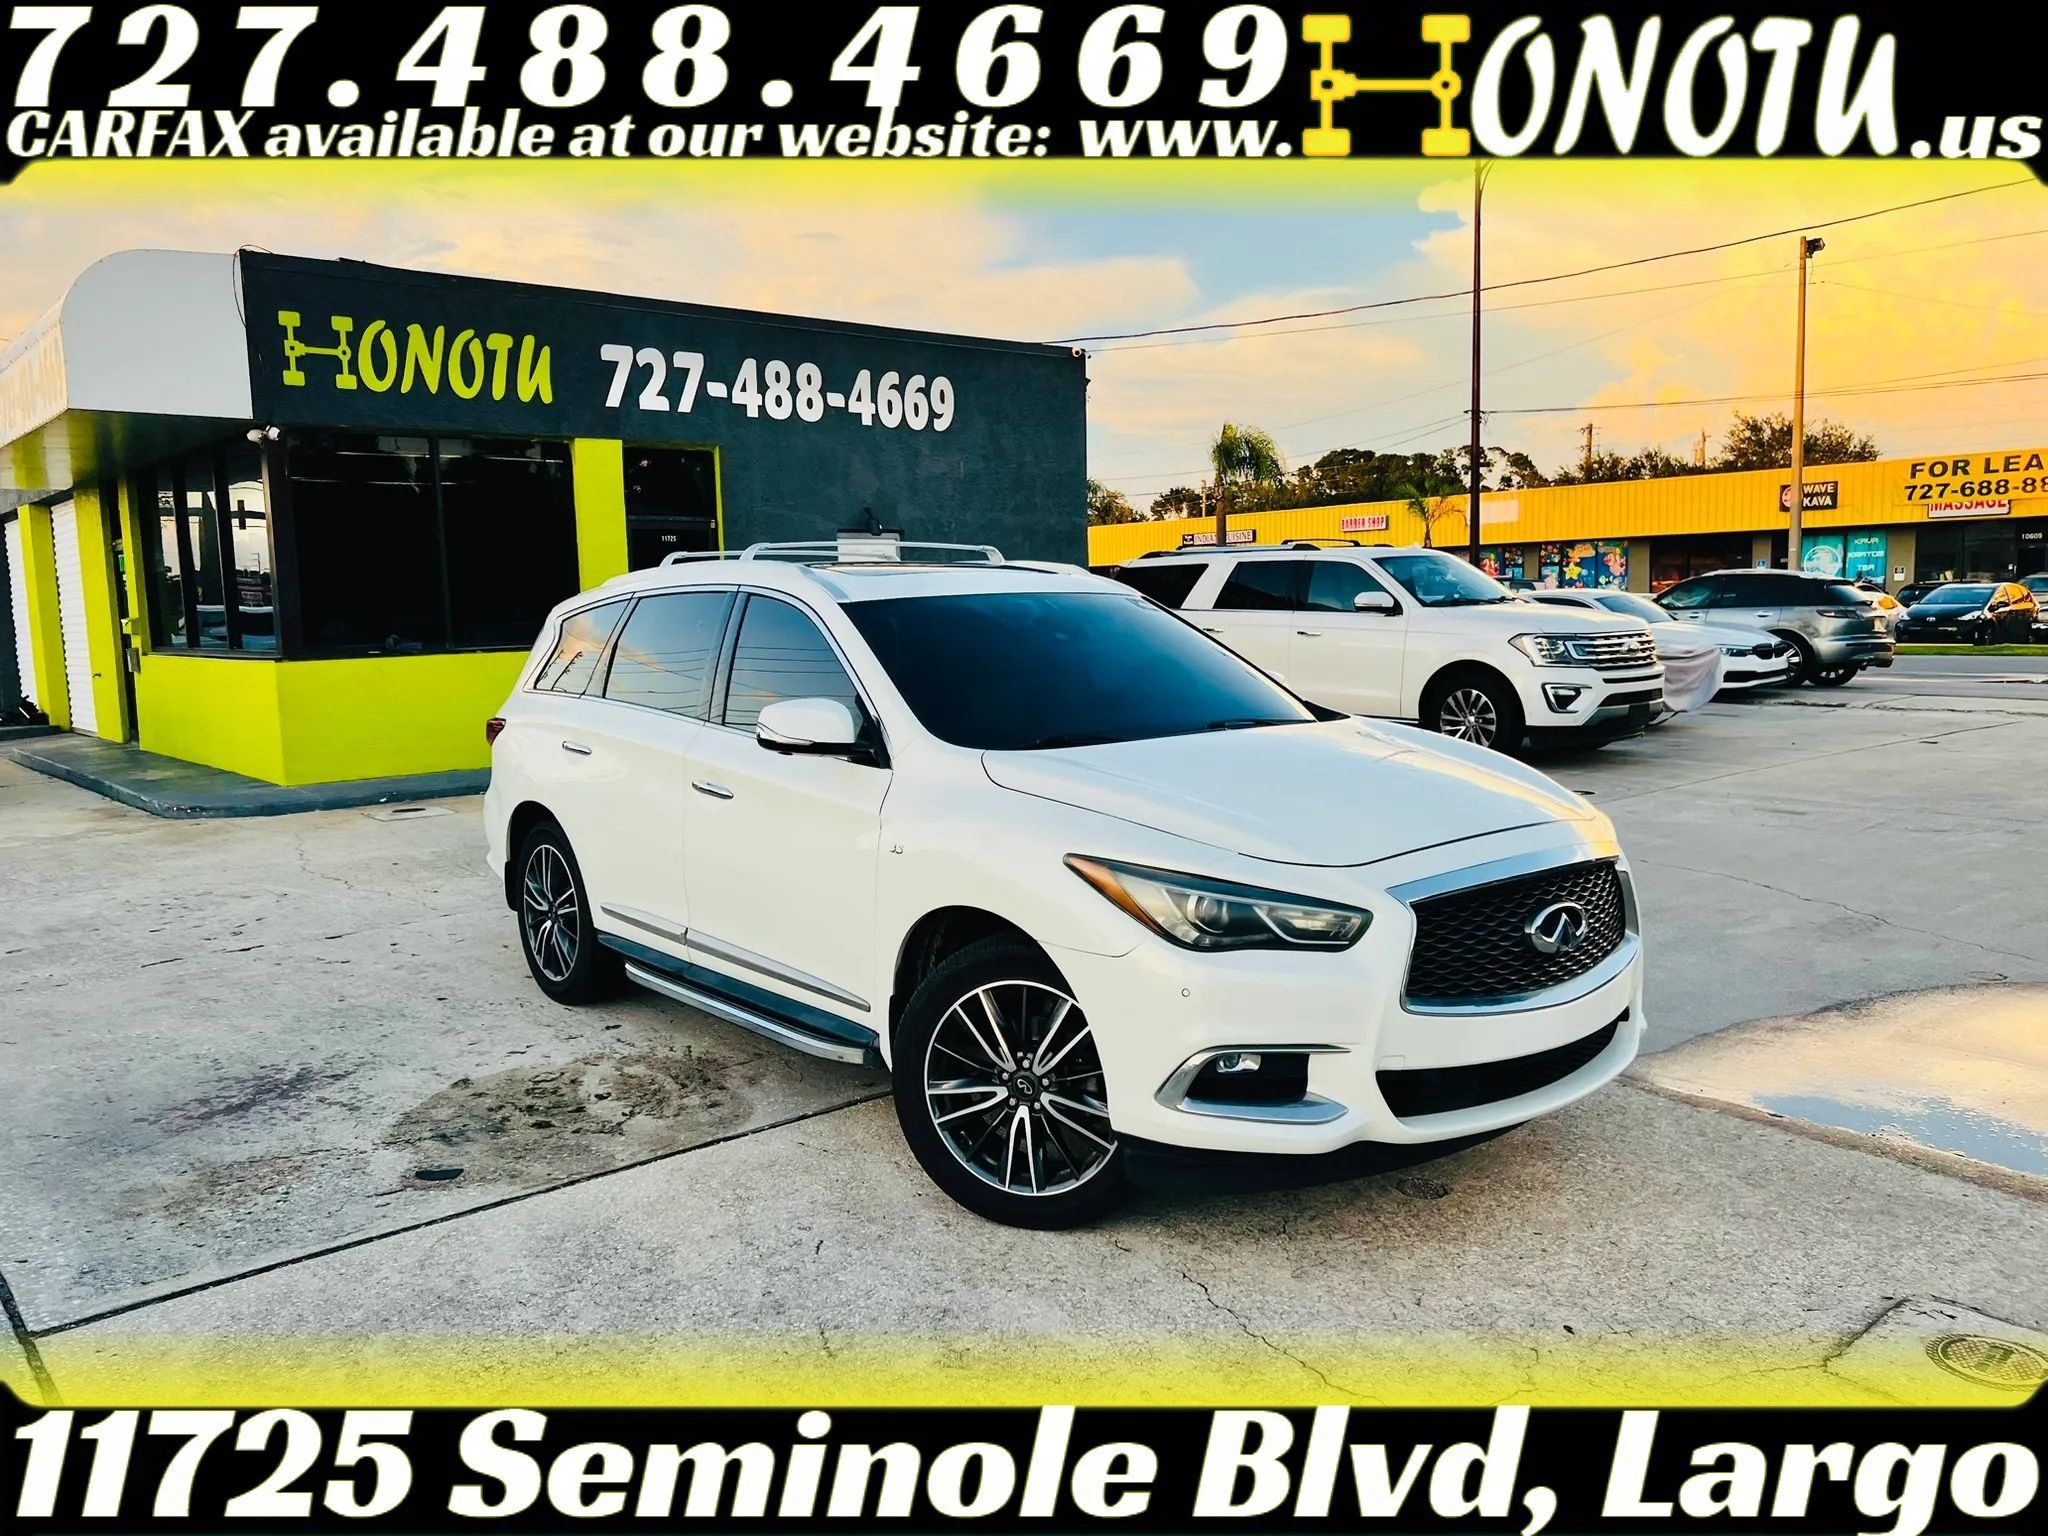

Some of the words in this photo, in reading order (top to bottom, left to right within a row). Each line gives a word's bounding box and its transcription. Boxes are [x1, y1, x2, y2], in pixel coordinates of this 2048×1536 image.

[278, 311, 553, 404] HONOTU
[601, 343, 956, 432] 727-488-4669
[1910, 459, 1971, 480] FOR
[1803, 483, 1835, 494] WAVE
[1802, 496, 1832, 507] KAVA
[1195, 532, 1217, 544] INDIA
[1226, 531, 1252, 542] UISINE
